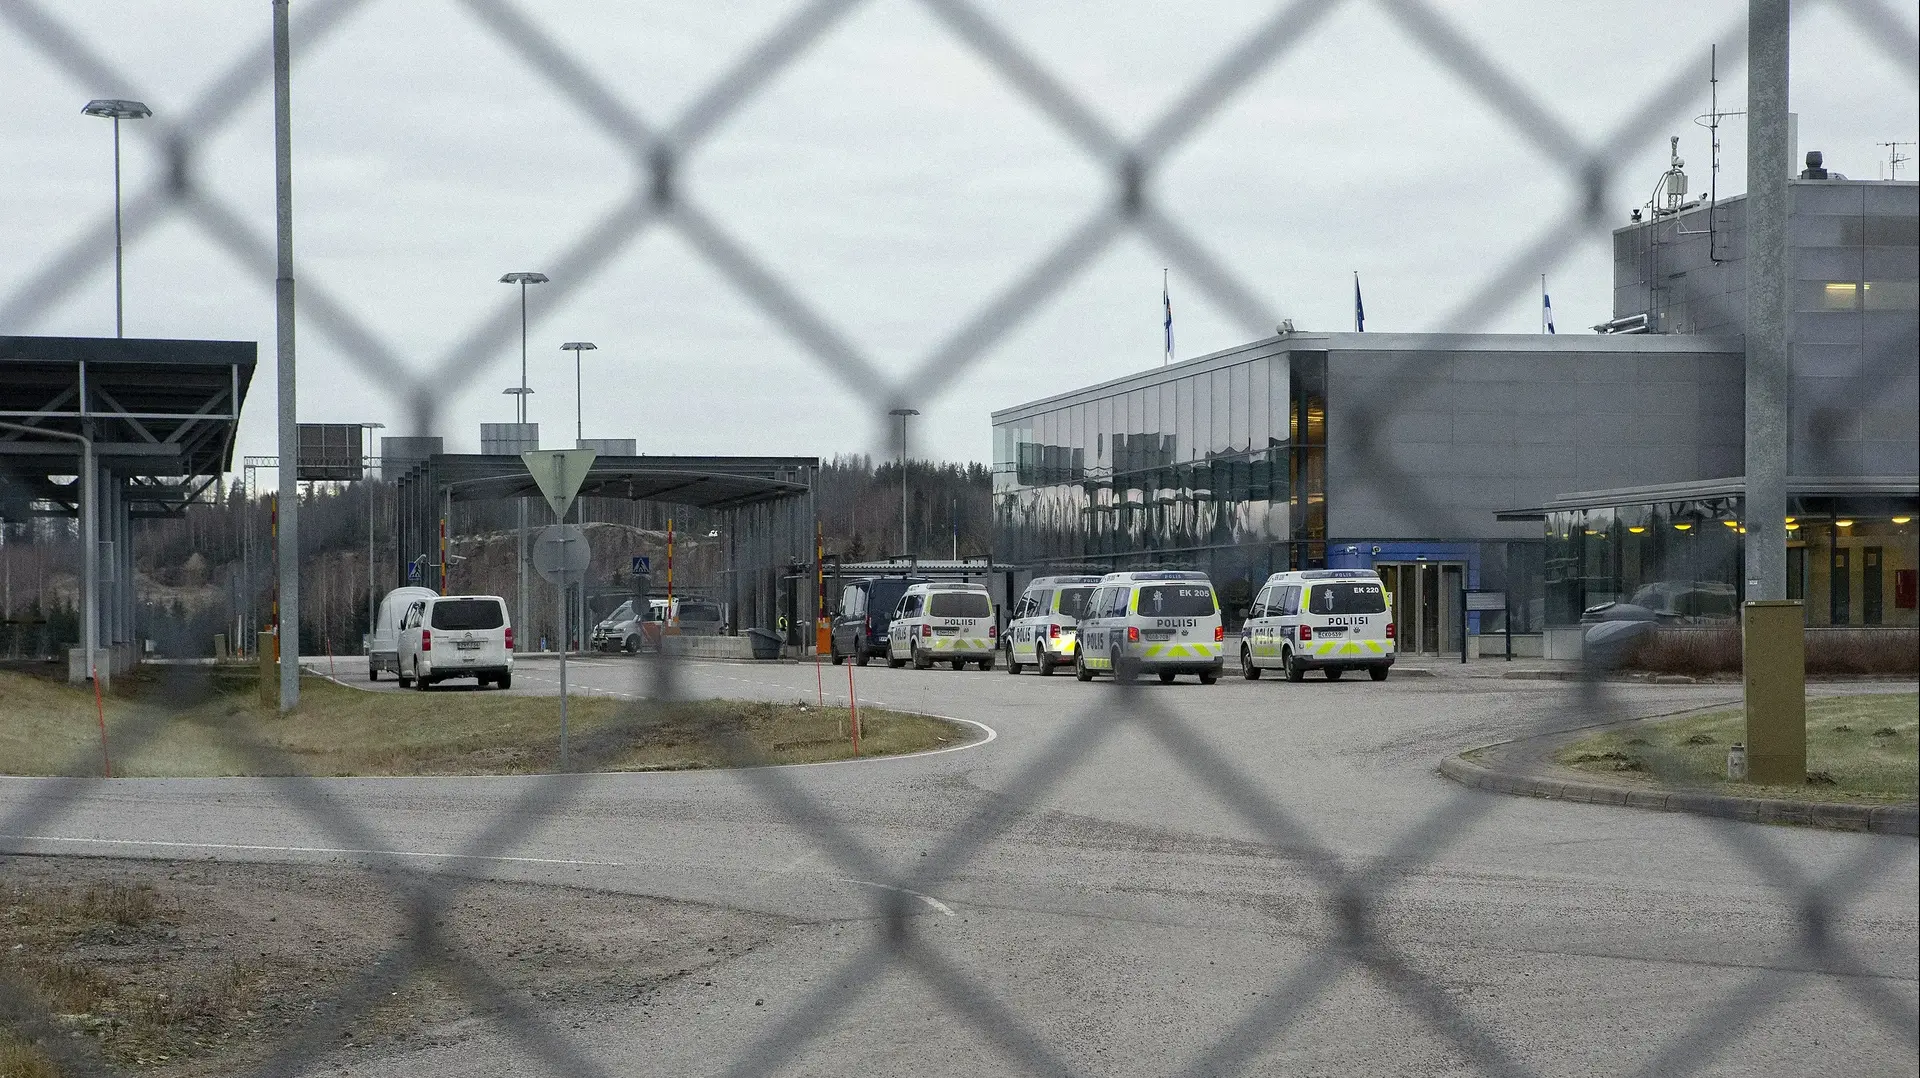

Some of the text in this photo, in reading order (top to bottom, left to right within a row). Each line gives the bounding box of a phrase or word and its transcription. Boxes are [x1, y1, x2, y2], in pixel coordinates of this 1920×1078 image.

[1179, 589, 1210, 597] EK 205
[944, 618, 976, 626] POLIISI
[1156, 618, 1197, 628] POLIISI
[1328, 616, 1369, 626] POLIISI
[1086, 632, 1104, 650] POLIS
